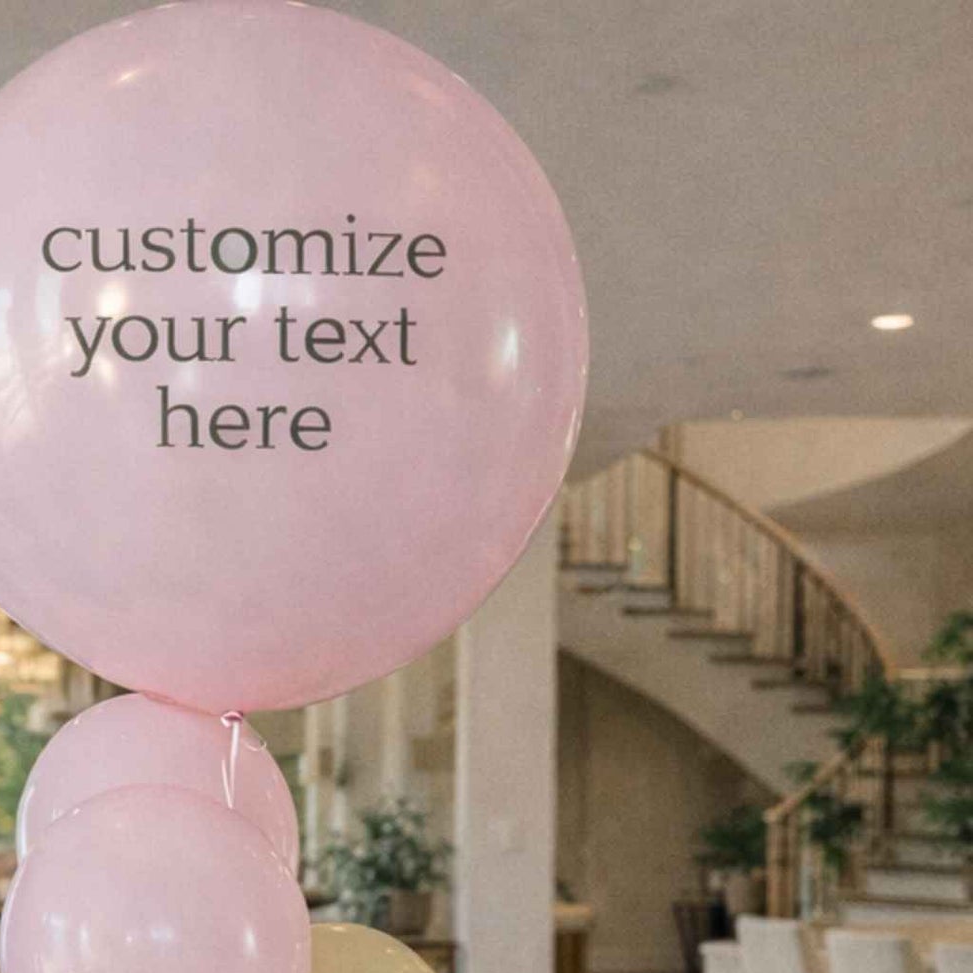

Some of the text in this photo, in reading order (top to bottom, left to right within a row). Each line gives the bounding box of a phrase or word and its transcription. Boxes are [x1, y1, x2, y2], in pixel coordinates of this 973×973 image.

[42, 213, 447, 279] customize
[64, 306, 418, 378] your text
[156, 385, 332, 452] here
